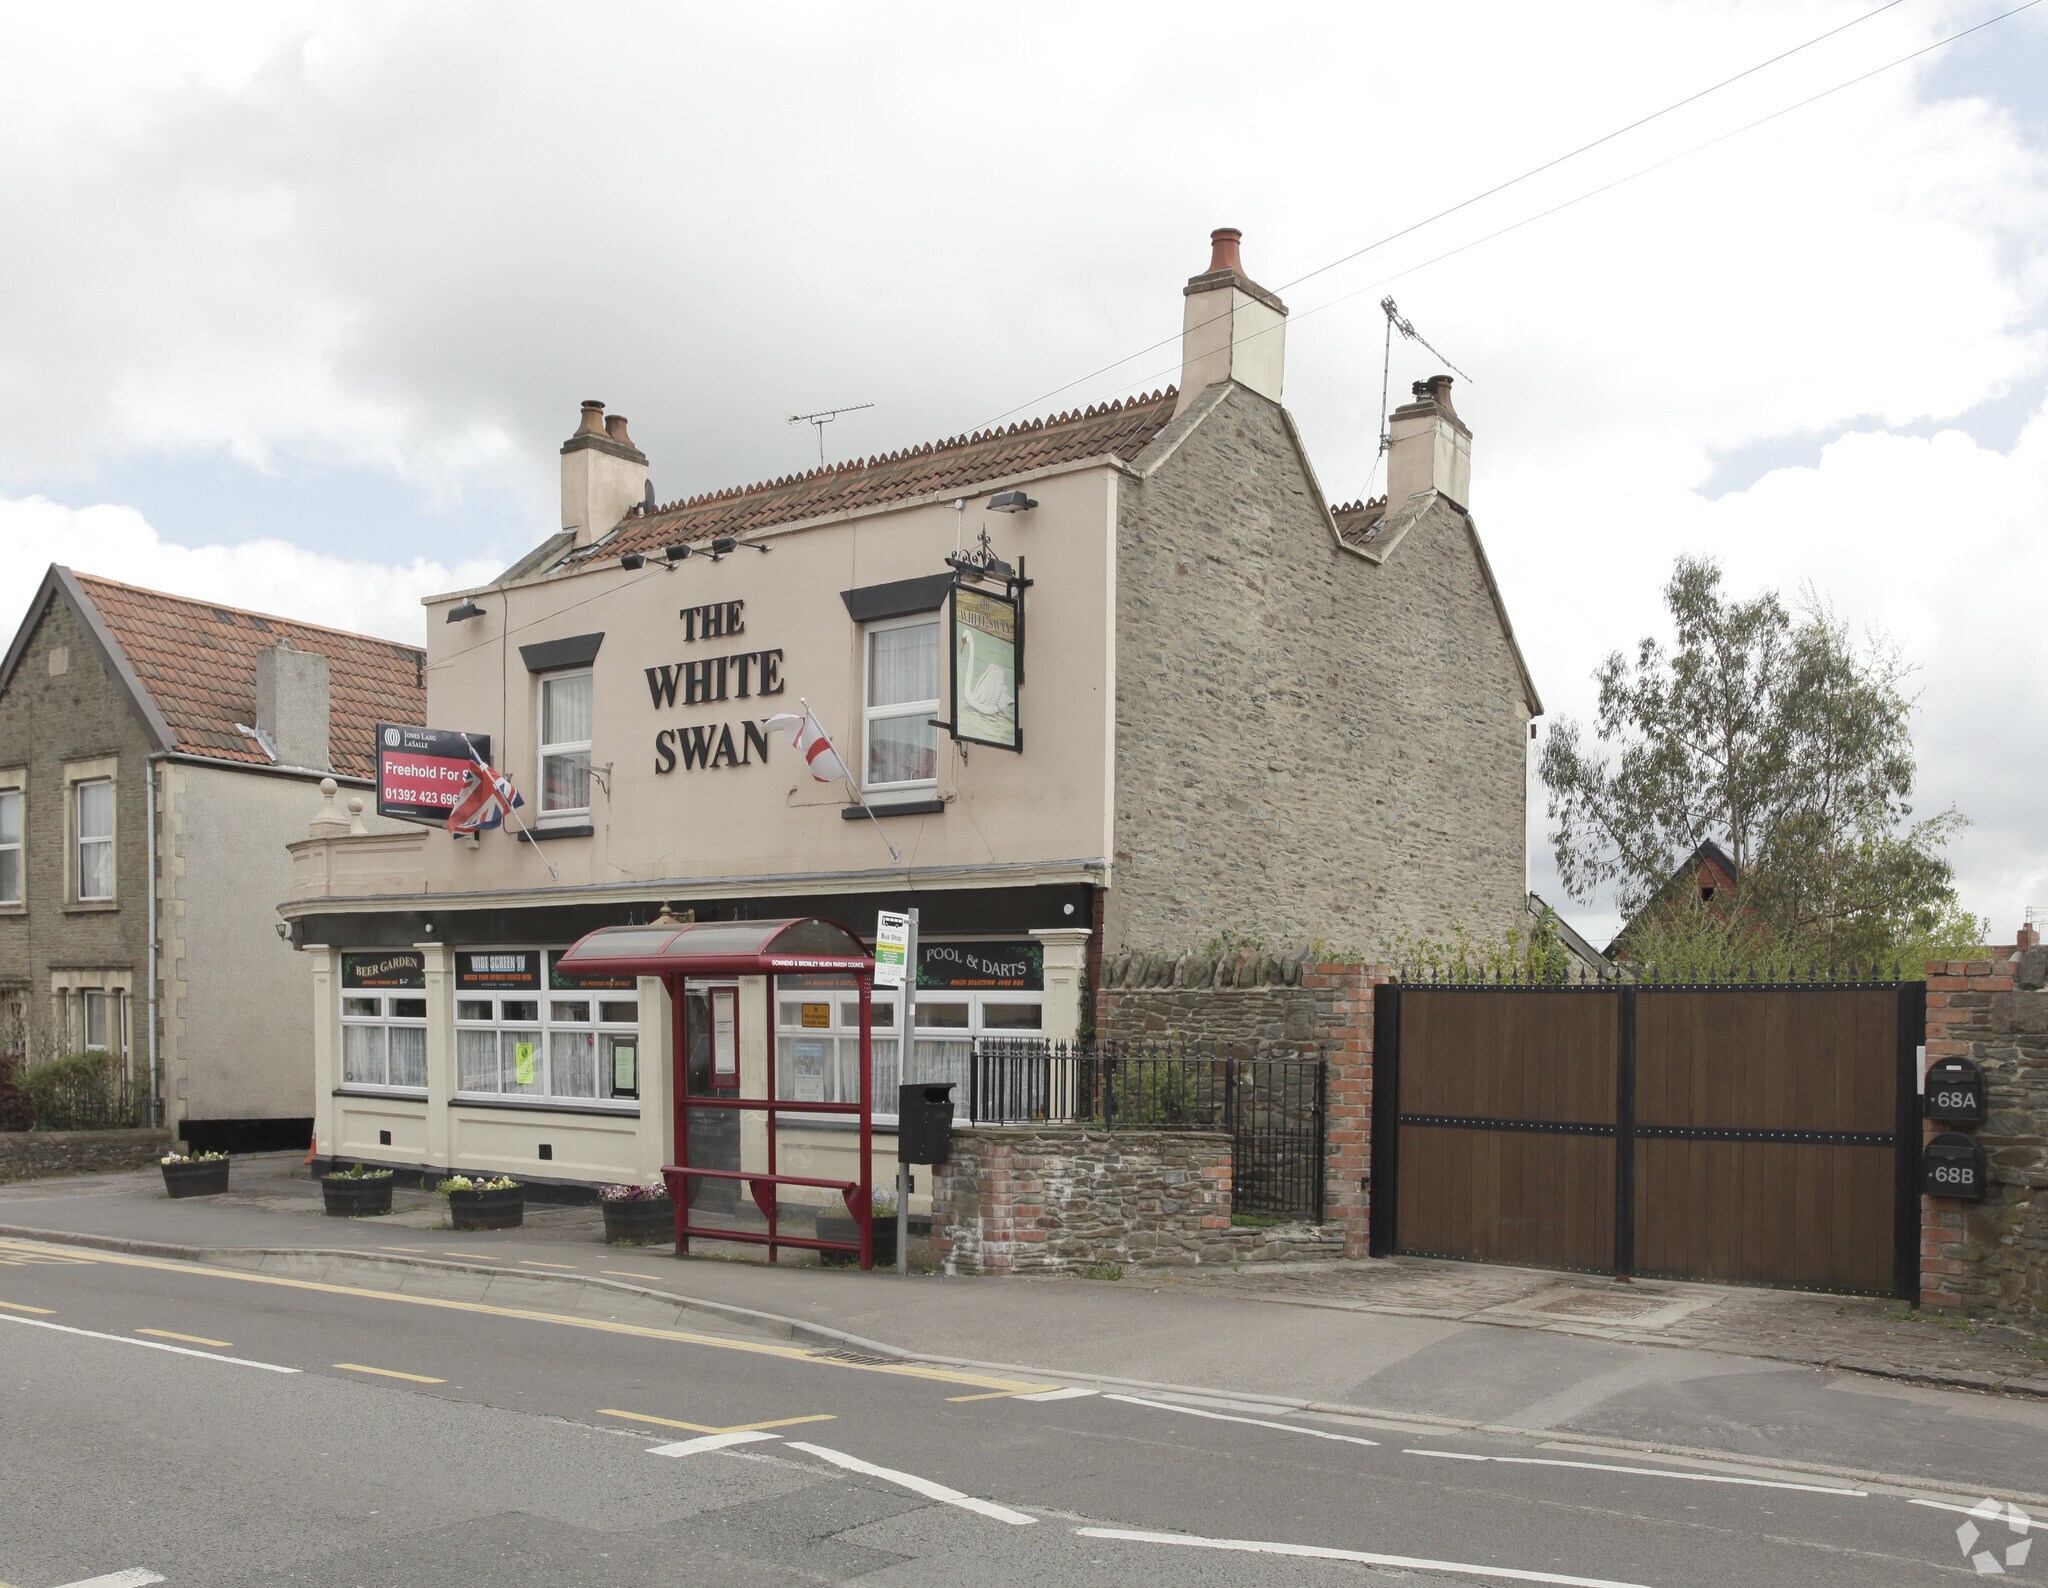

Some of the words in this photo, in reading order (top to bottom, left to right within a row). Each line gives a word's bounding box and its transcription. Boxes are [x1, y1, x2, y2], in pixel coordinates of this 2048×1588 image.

[680, 599, 745, 642] THE
[644, 648, 785, 710] WHITE
[421, 733, 437, 742] LANG
[655, 719, 770, 775] SWAN
[385, 761, 436, 778] Freehold
[440, 767, 459, 780] For
[385, 787, 416, 802] 01392
[419, 790, 438, 804] 423
[881, 932, 890, 940] Bus
[891, 934, 902, 942] Stop
[356, 964, 379, 976] BEER
[380, 956, 418, 972] GARDEN
[471, 955, 489, 972] WIDE
[490, 955, 516, 972] SCREEN
[516, 955, 526, 972] TV
[926, 948, 962, 963] POOL
[966, 954, 978, 970] &
[982, 959, 1026, 977] DARTS
[1937, 1092, 1976, 1108] 68A
[1935, 1166, 1974, 1184] 68B
